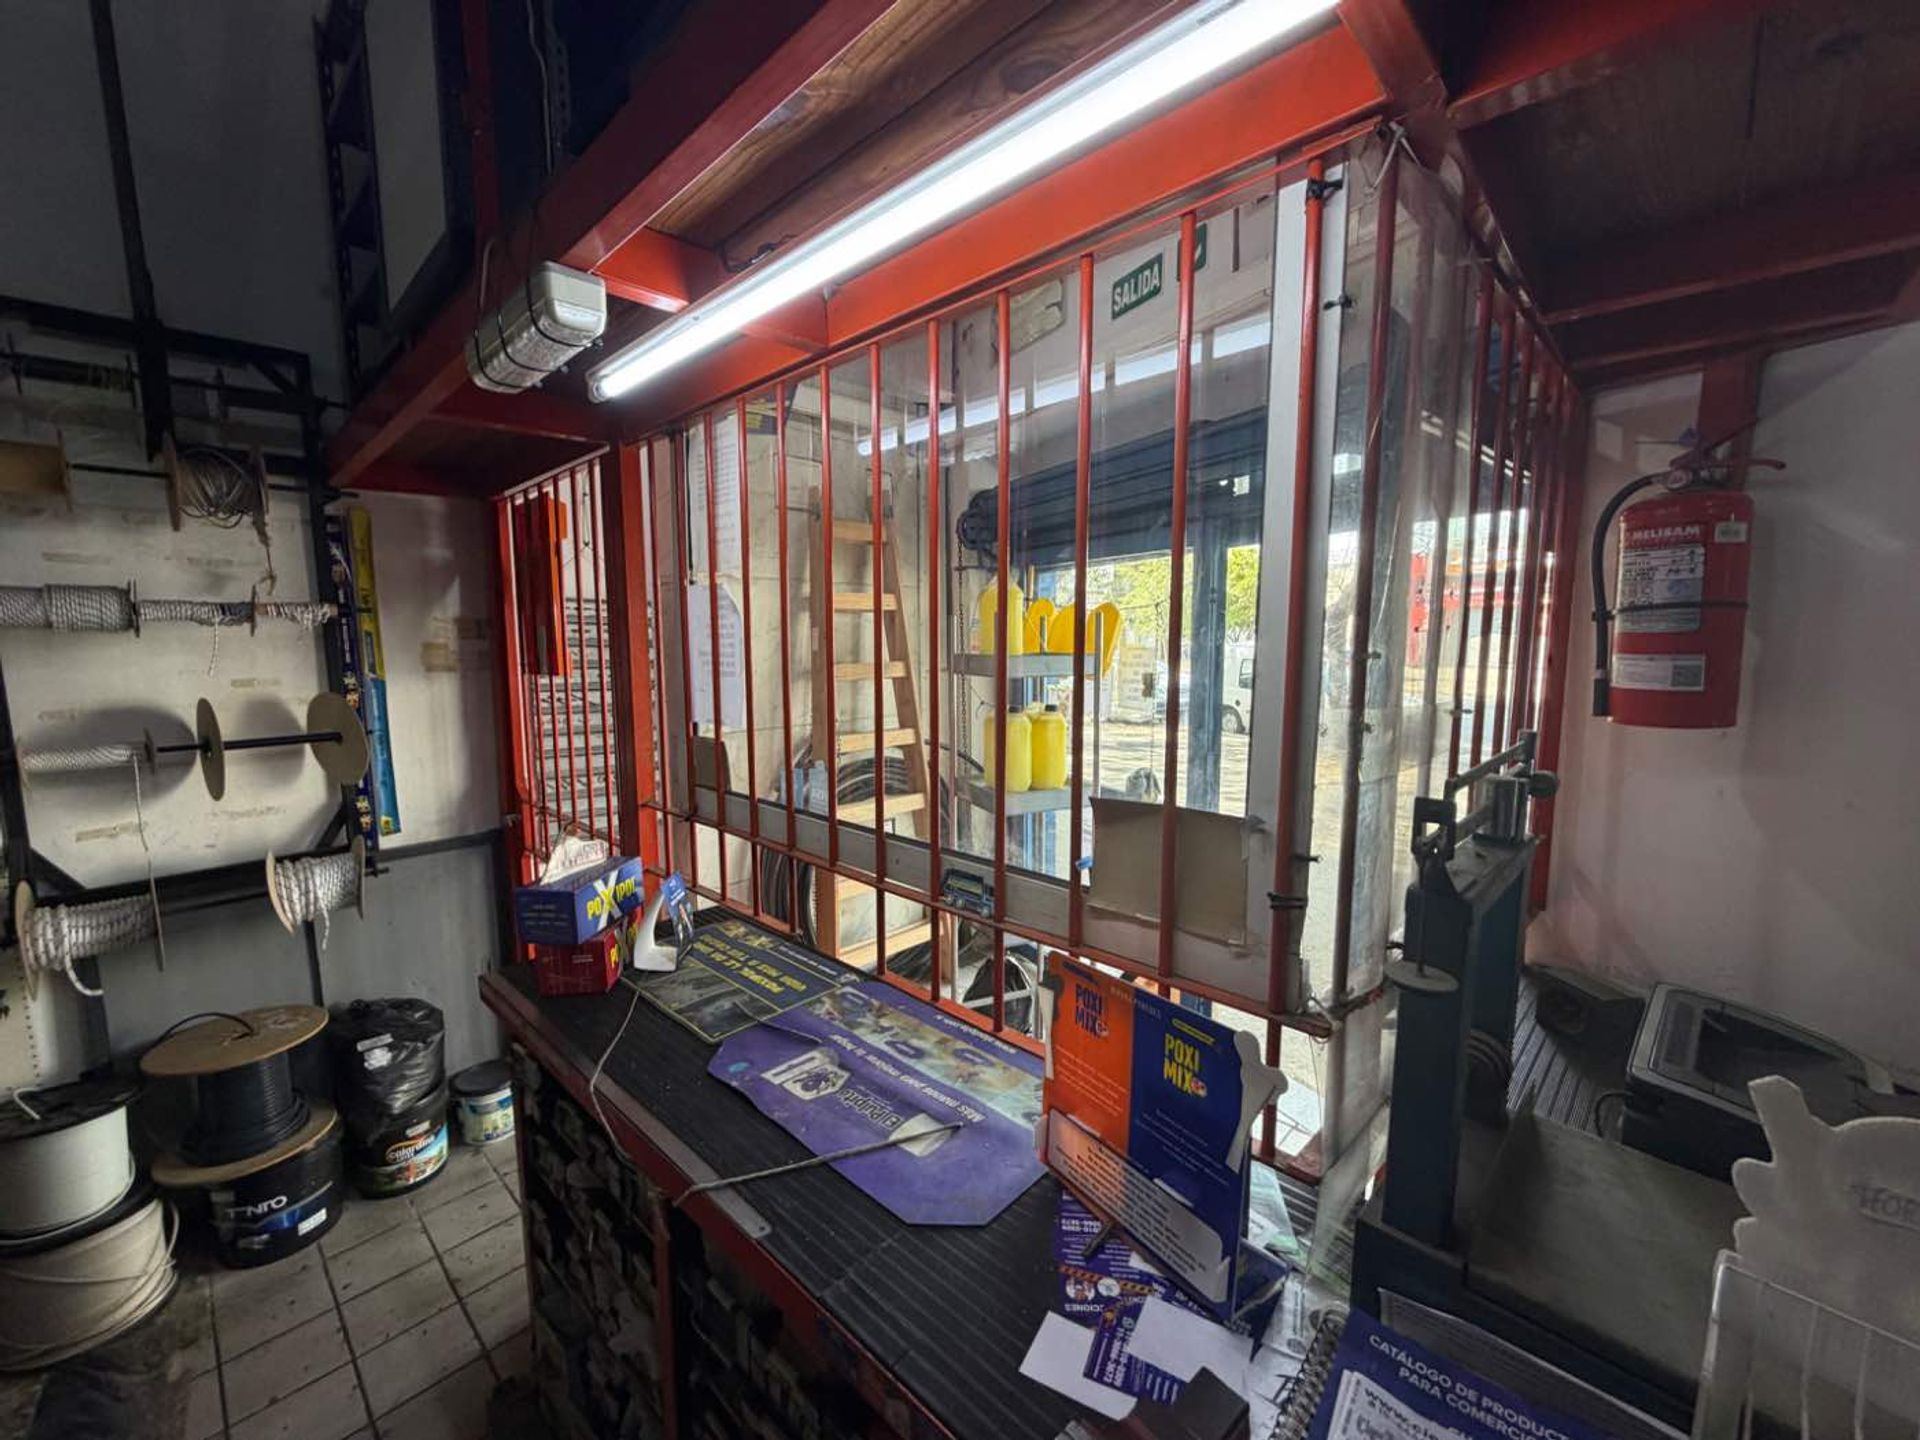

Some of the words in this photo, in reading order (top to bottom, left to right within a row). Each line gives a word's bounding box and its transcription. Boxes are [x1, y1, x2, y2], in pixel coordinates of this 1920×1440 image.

[1113, 263, 1160, 312] SALIDA
[1075, 983, 1103, 1015] POXI
[1075, 1004, 1100, 1039] MIX
[1164, 1033, 1200, 1073] POXI
[1163, 1057, 1193, 1094] MIX
[836, 1090, 889, 1122] Pulpito
[881, 1111, 902, 1129] El
[1368, 1334, 1452, 1388] CATÁLOGO
[1455, 1381, 1480, 1402] DE
[1398, 1367, 1442, 1401] PARA
